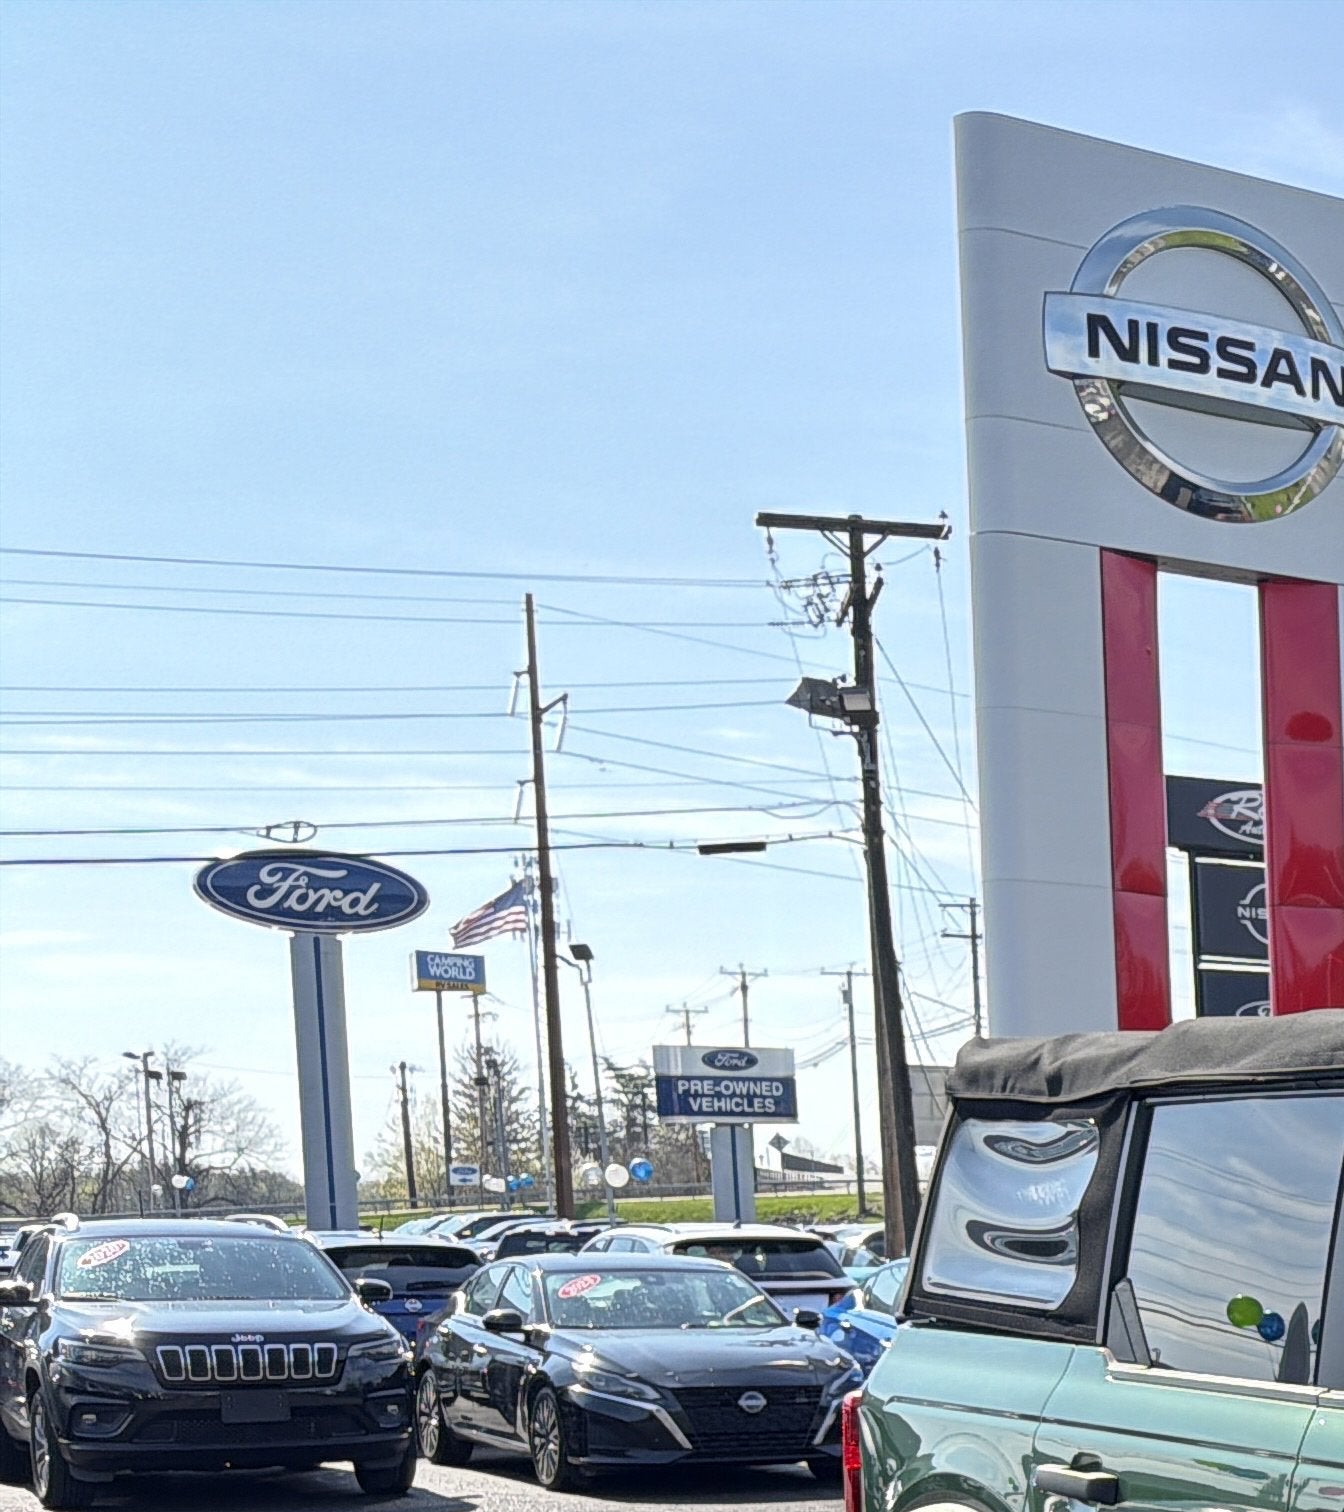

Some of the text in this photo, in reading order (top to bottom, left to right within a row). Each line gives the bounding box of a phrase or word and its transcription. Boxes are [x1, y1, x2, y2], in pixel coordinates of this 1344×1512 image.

[246, 862, 382, 916] Ford
[427, 955, 475, 968] CAMPING
[428, 963, 476, 980] WORLD
[715, 1052, 747, 1067] Ford
[677, 1079, 783, 1097] PRE-OWNED
[688, 1097, 776, 1113] VEHICLES
[231, 1333, 264, 1343] Jeep
